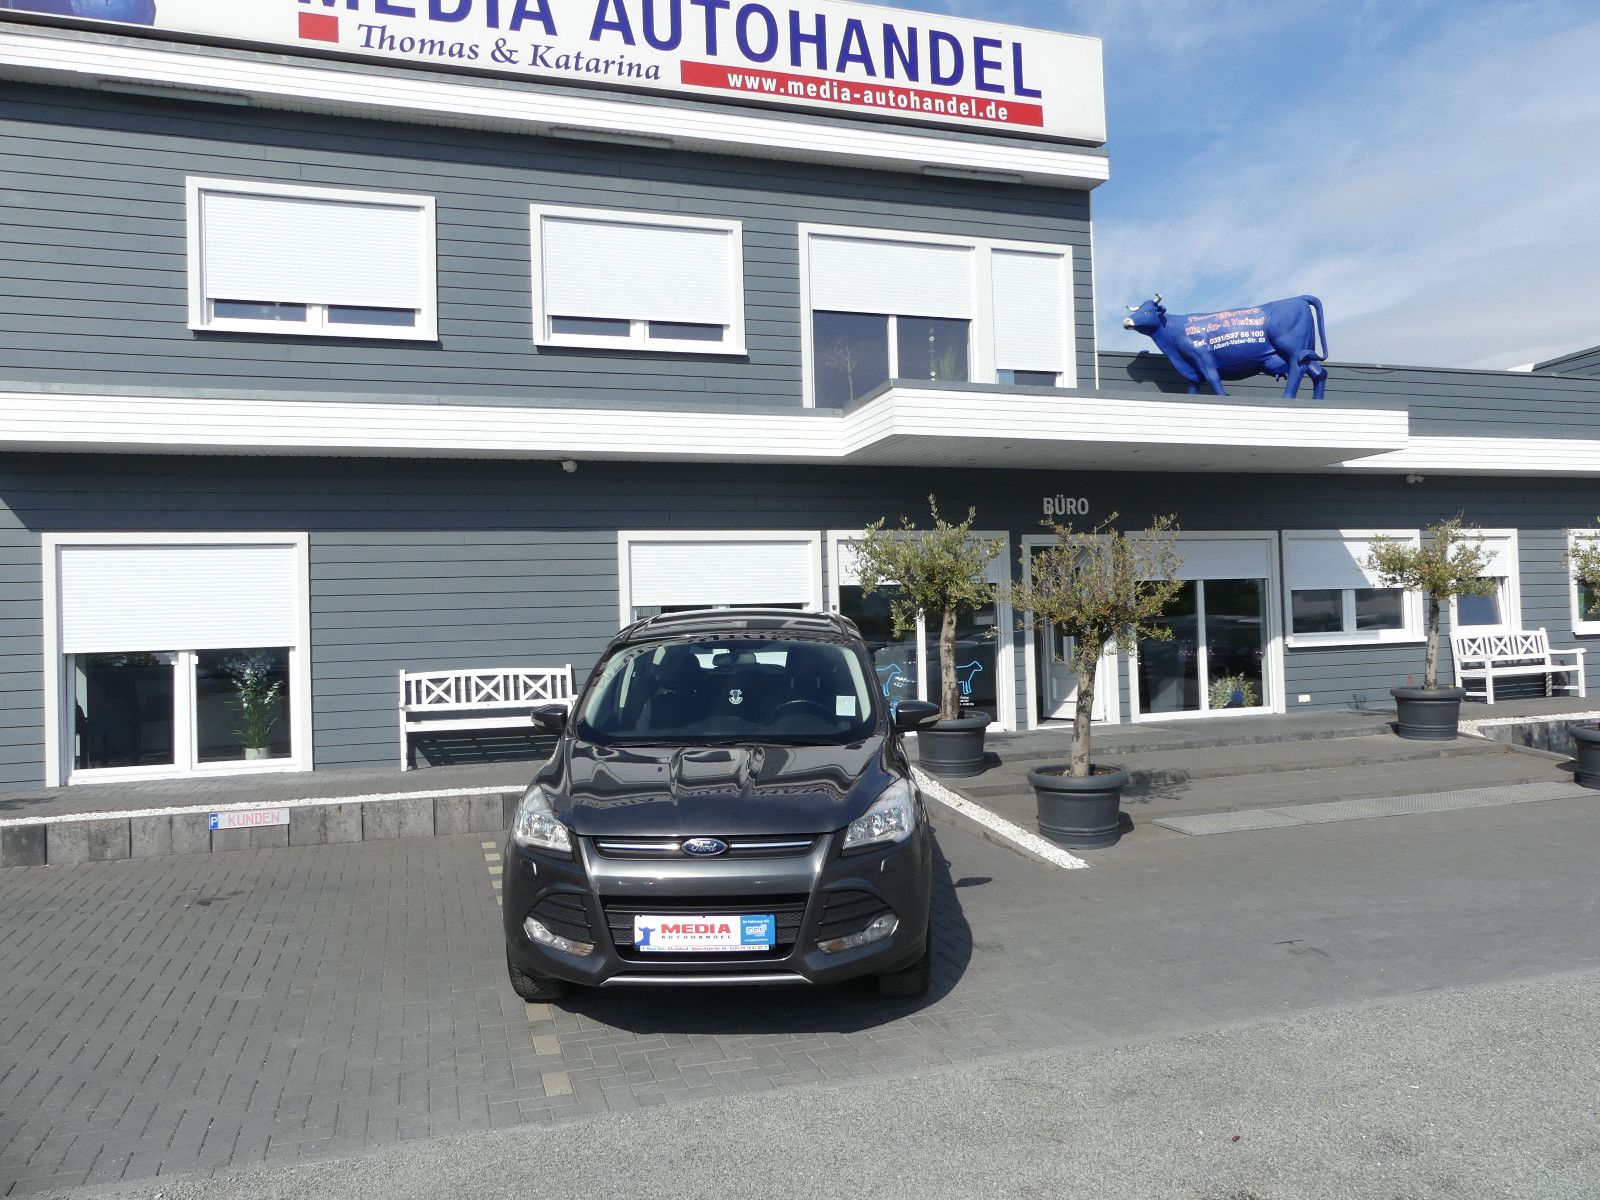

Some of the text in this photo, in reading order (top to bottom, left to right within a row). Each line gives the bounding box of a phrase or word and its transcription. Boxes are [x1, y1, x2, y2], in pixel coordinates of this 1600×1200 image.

[357, 23, 661, 81] Thomas & Katarina
[590, 0, 1041, 98] AUTOHANDEL
[727, 73, 1008, 121] www.media-autohandel.de
[1043, 494, 1089, 515] BÜRO
[210, 811, 279, 827] P KUNDEN
[691, 842, 717, 852] Ford
[661, 923, 731, 934] MEDIA
